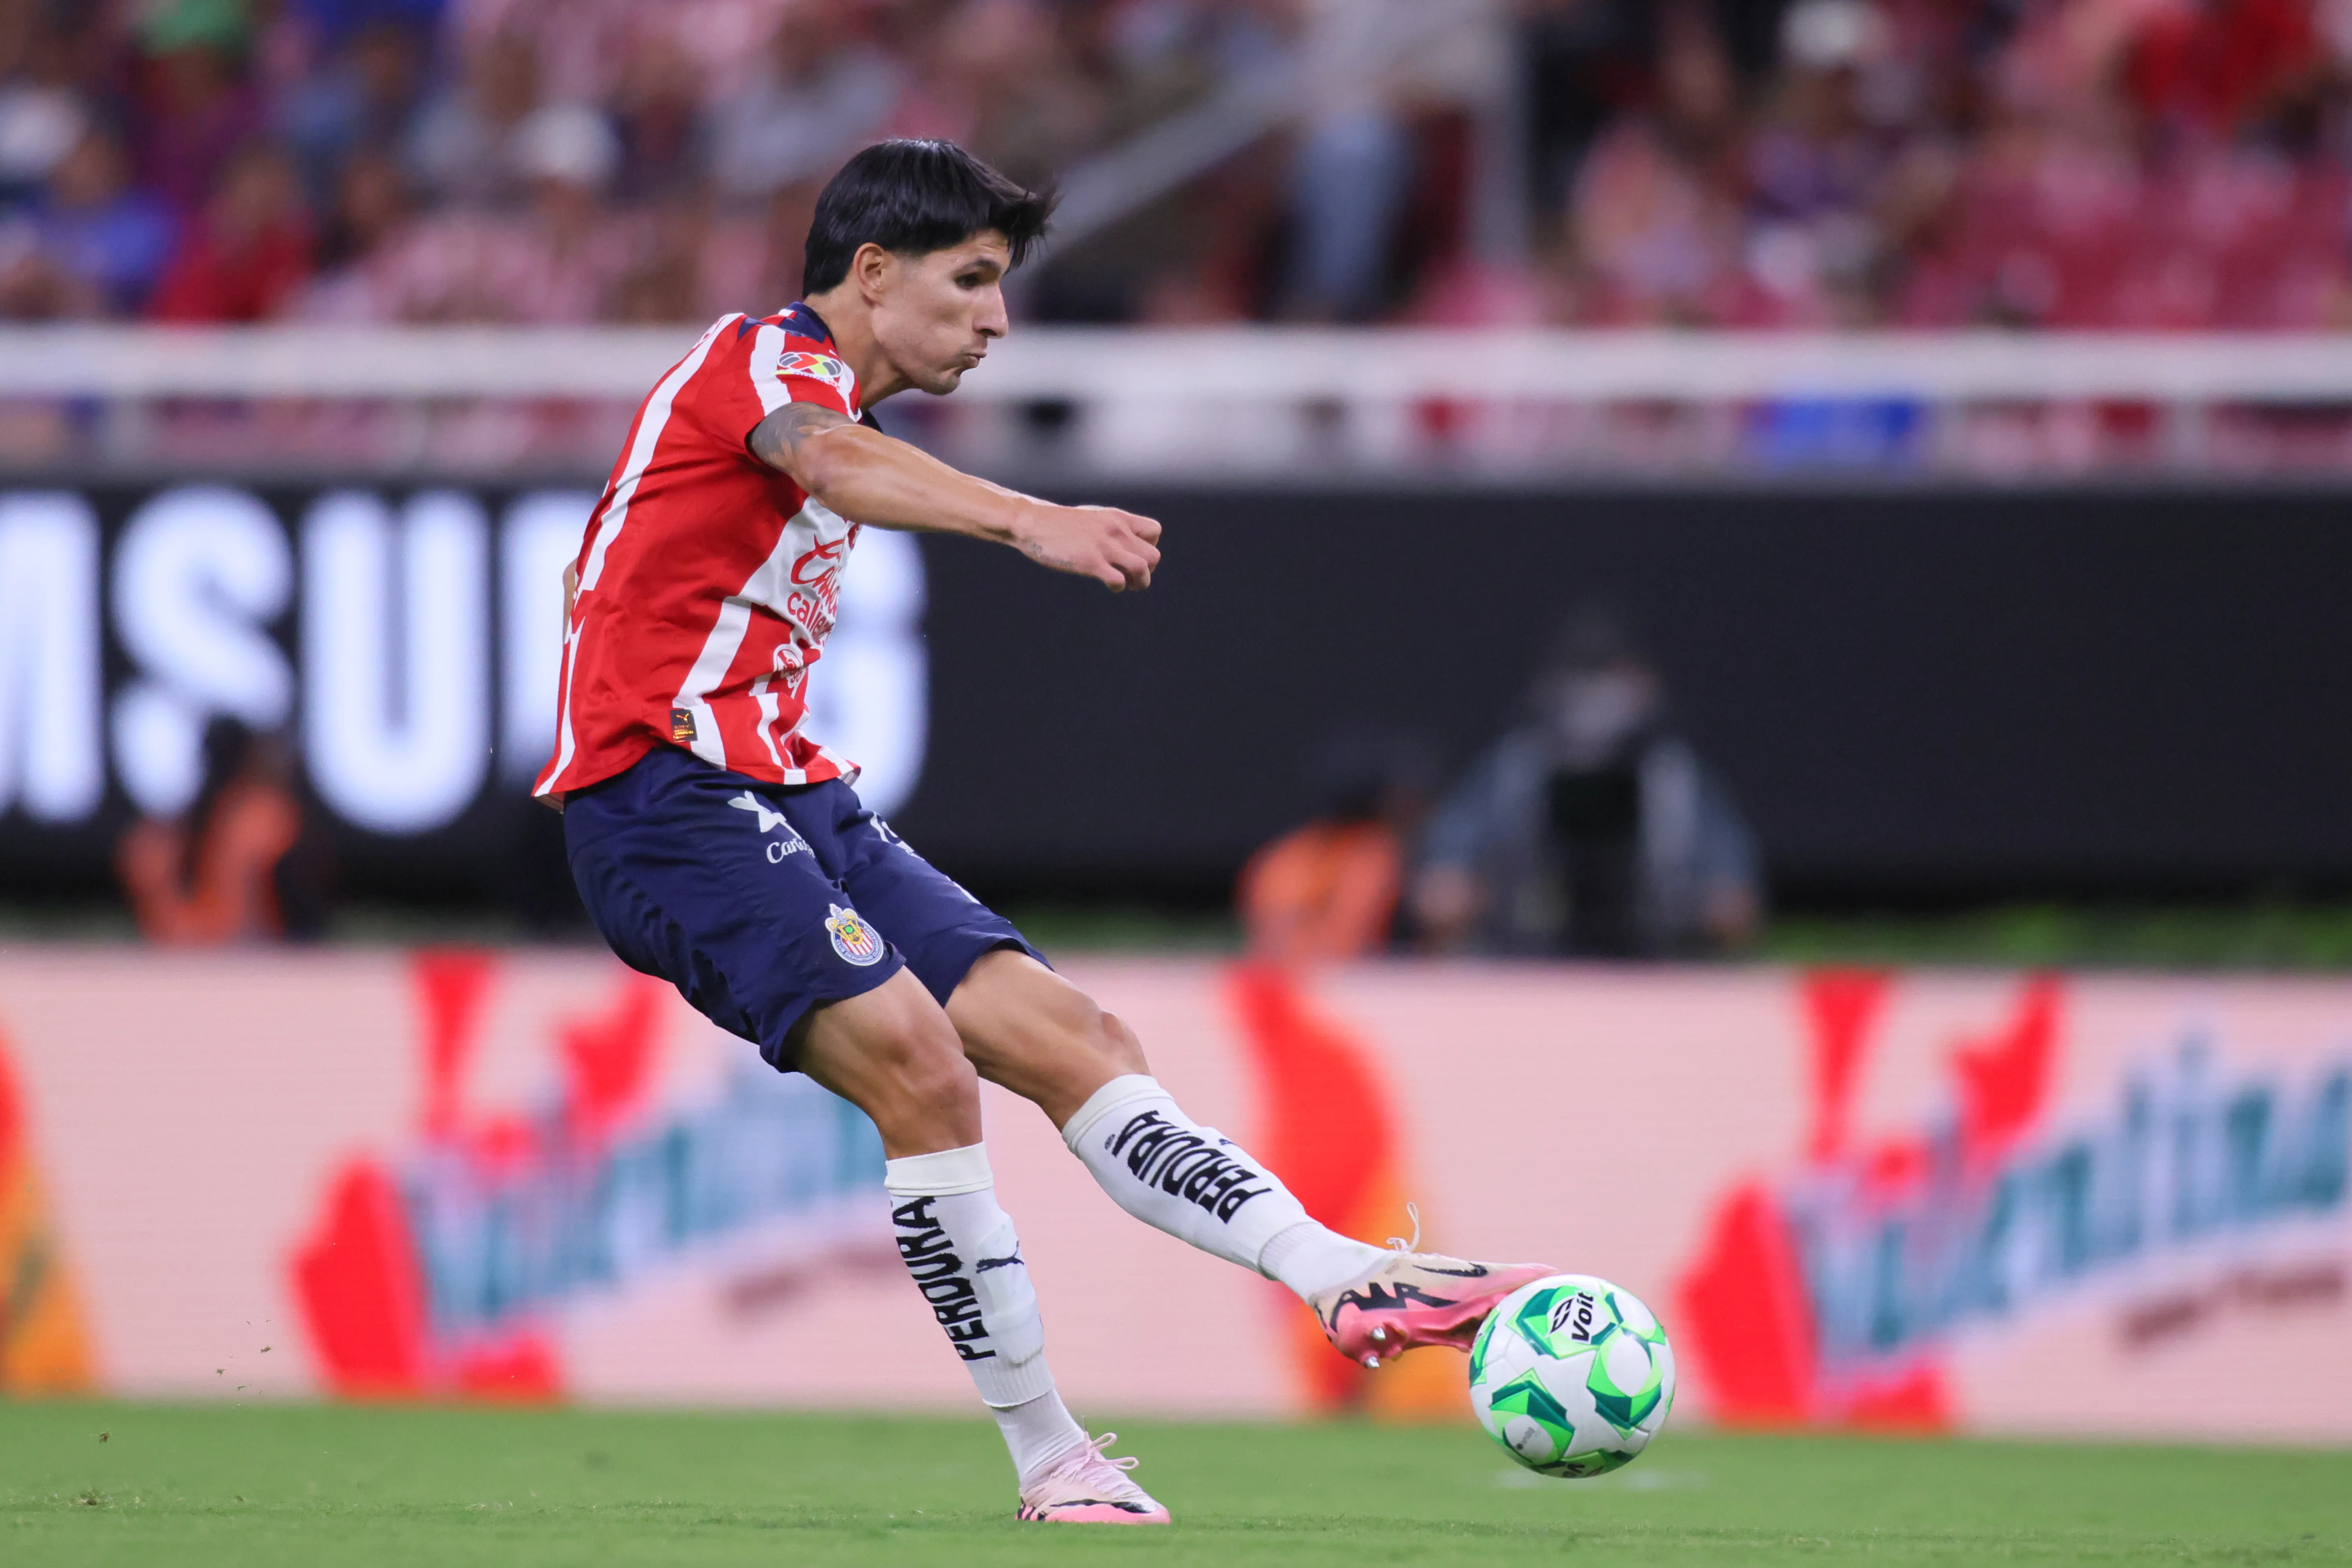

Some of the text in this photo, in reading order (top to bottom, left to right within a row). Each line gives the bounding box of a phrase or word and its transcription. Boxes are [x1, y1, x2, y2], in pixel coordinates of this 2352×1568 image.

[1111, 1110, 1273, 1225] PERDURA
[892, 1196, 997, 1361] PERDURA
[1572, 1292, 1594, 1342] Voit
